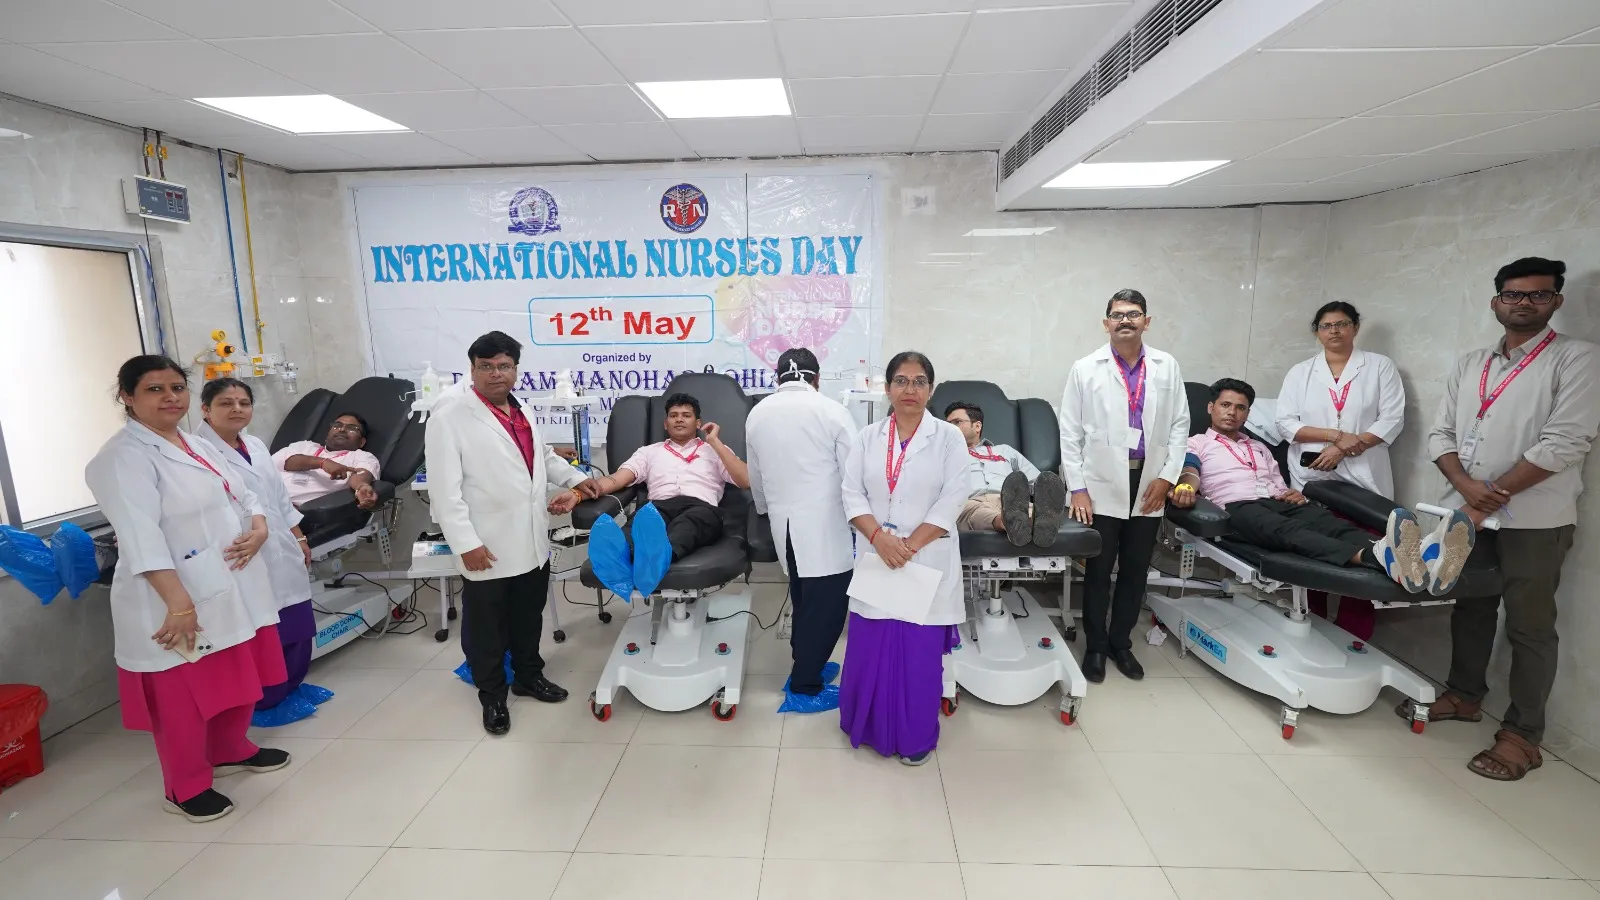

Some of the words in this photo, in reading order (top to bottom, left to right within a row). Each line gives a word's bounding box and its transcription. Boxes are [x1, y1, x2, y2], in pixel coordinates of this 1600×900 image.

[371, 239, 638, 283] INTERNATIONAL
[643, 236, 783, 278] NURSES
[791, 235, 863, 276] DAY
[550, 306, 613, 336] 12th
[624, 311, 697, 341] May
[582, 352, 636, 364] Organized
[638, 351, 652, 364] by
[511, 371, 557, 391] AM
[570, 369, 695, 391] MANOHA
[320, 622, 340, 639] BLOOD
